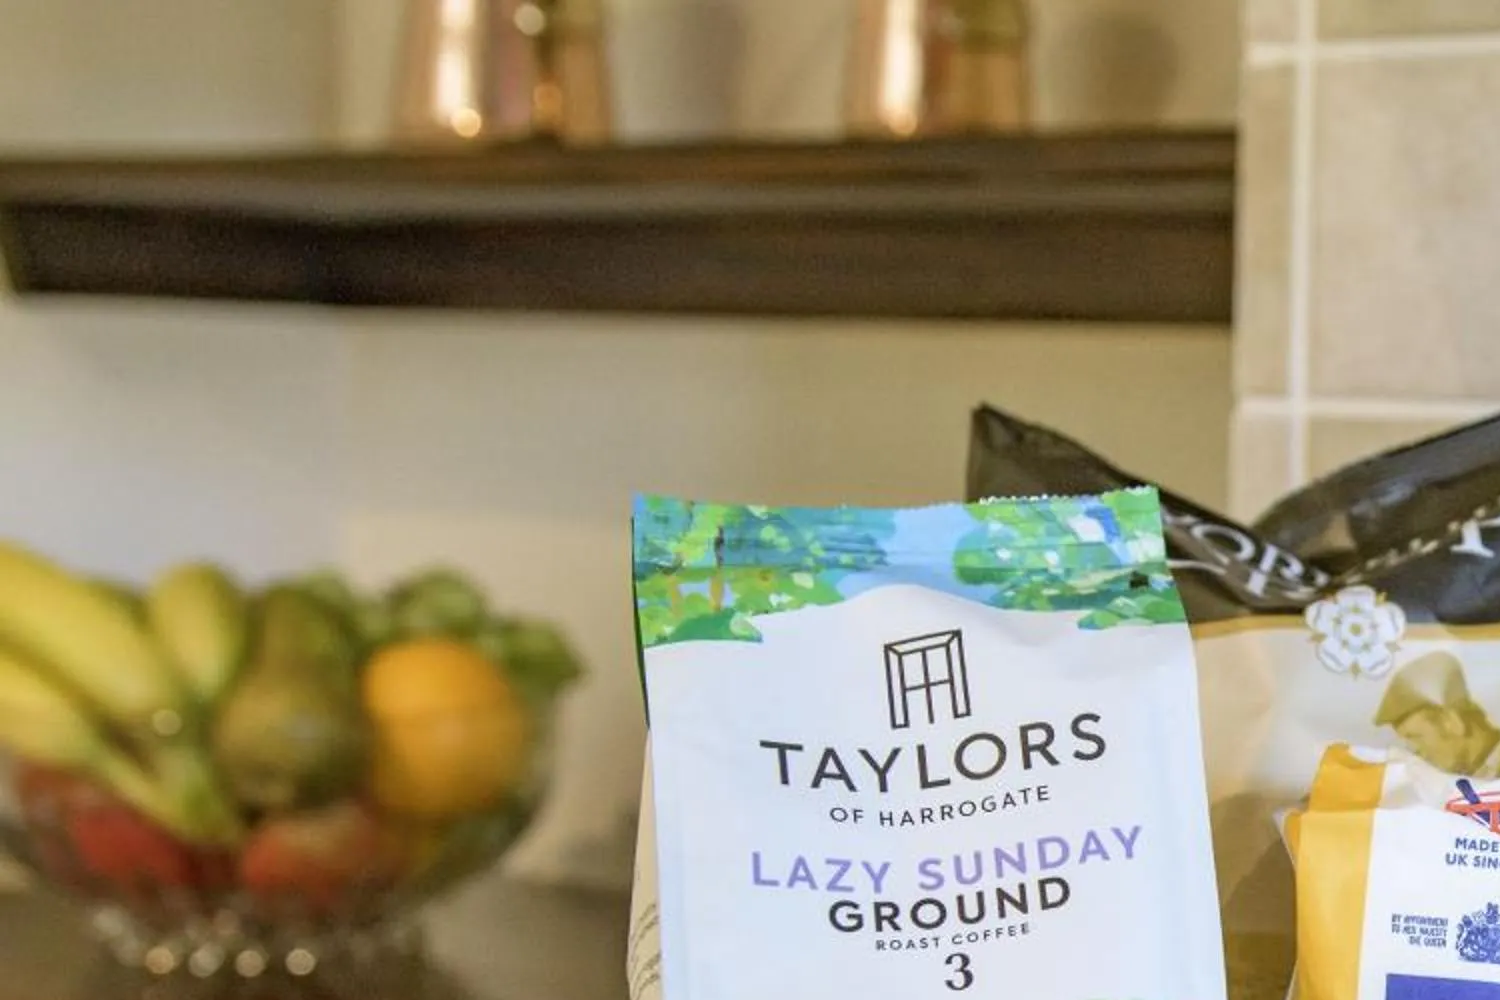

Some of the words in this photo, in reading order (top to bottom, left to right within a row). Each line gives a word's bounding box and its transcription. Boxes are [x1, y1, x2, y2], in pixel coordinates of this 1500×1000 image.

[760, 712, 1107, 793] TAYLORS
[829, 806, 864, 824] OF
[879, 785, 1051, 827] HARROGATE
[751, 851, 891, 893] LAZY
[917, 824, 1142, 891] SUNDAY
[1445, 852, 1468, 866] UK
[1455, 837, 1500, 853] MADE
[828, 876, 1070, 933] GROUND
[875, 936, 941, 951] ROAST
[951, 922, 1030, 946] COFFEE
[943, 952, 974, 991] 3
